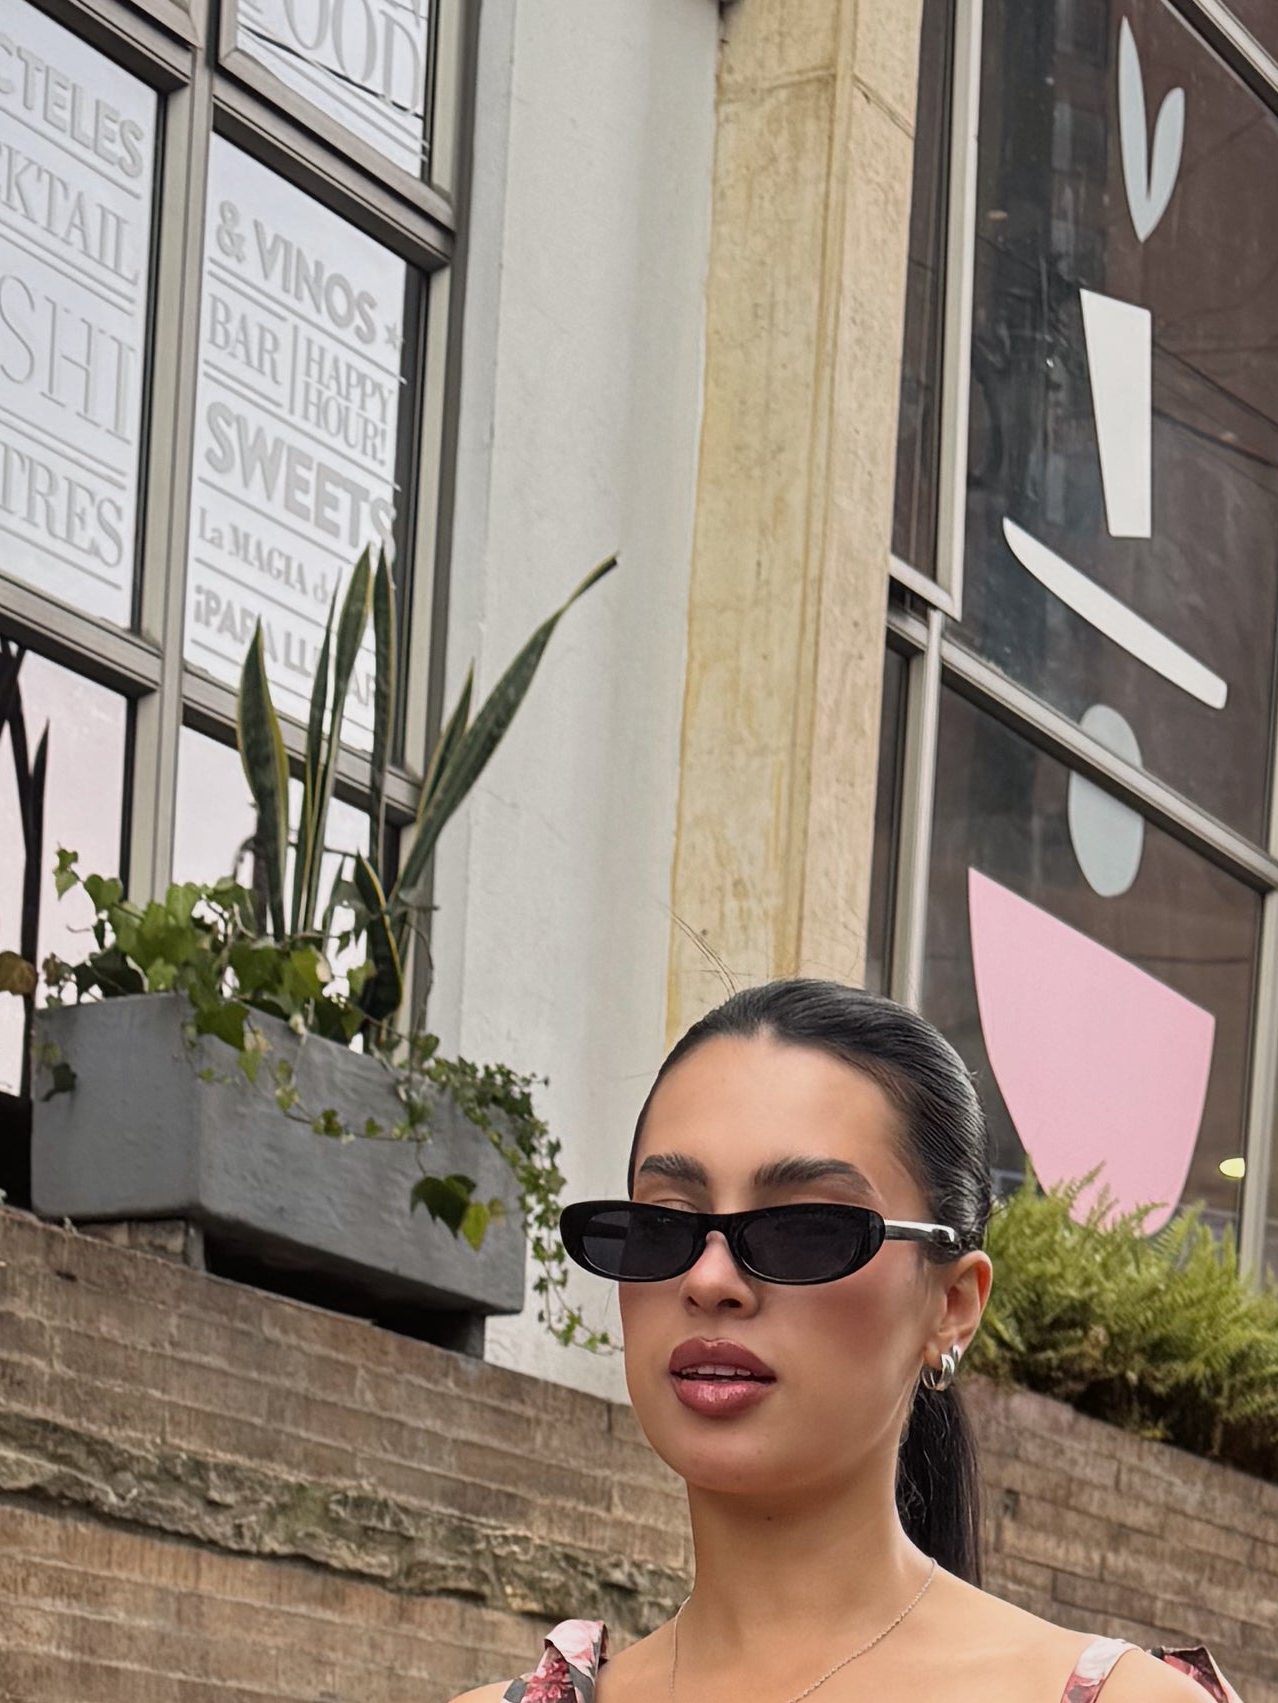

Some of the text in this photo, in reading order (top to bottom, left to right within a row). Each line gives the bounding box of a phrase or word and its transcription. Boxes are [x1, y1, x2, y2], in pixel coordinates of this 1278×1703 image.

[216, 200, 378, 345] & VINOS
[207, 293, 282, 386] BAR
[305, 336, 395, 425] HAPPY
[300, 379, 388, 468] HOUR!
[204, 402, 397, 572] SWEETS
[198, 506, 225, 552] La
[228, 522, 308, 597] MAGIA
